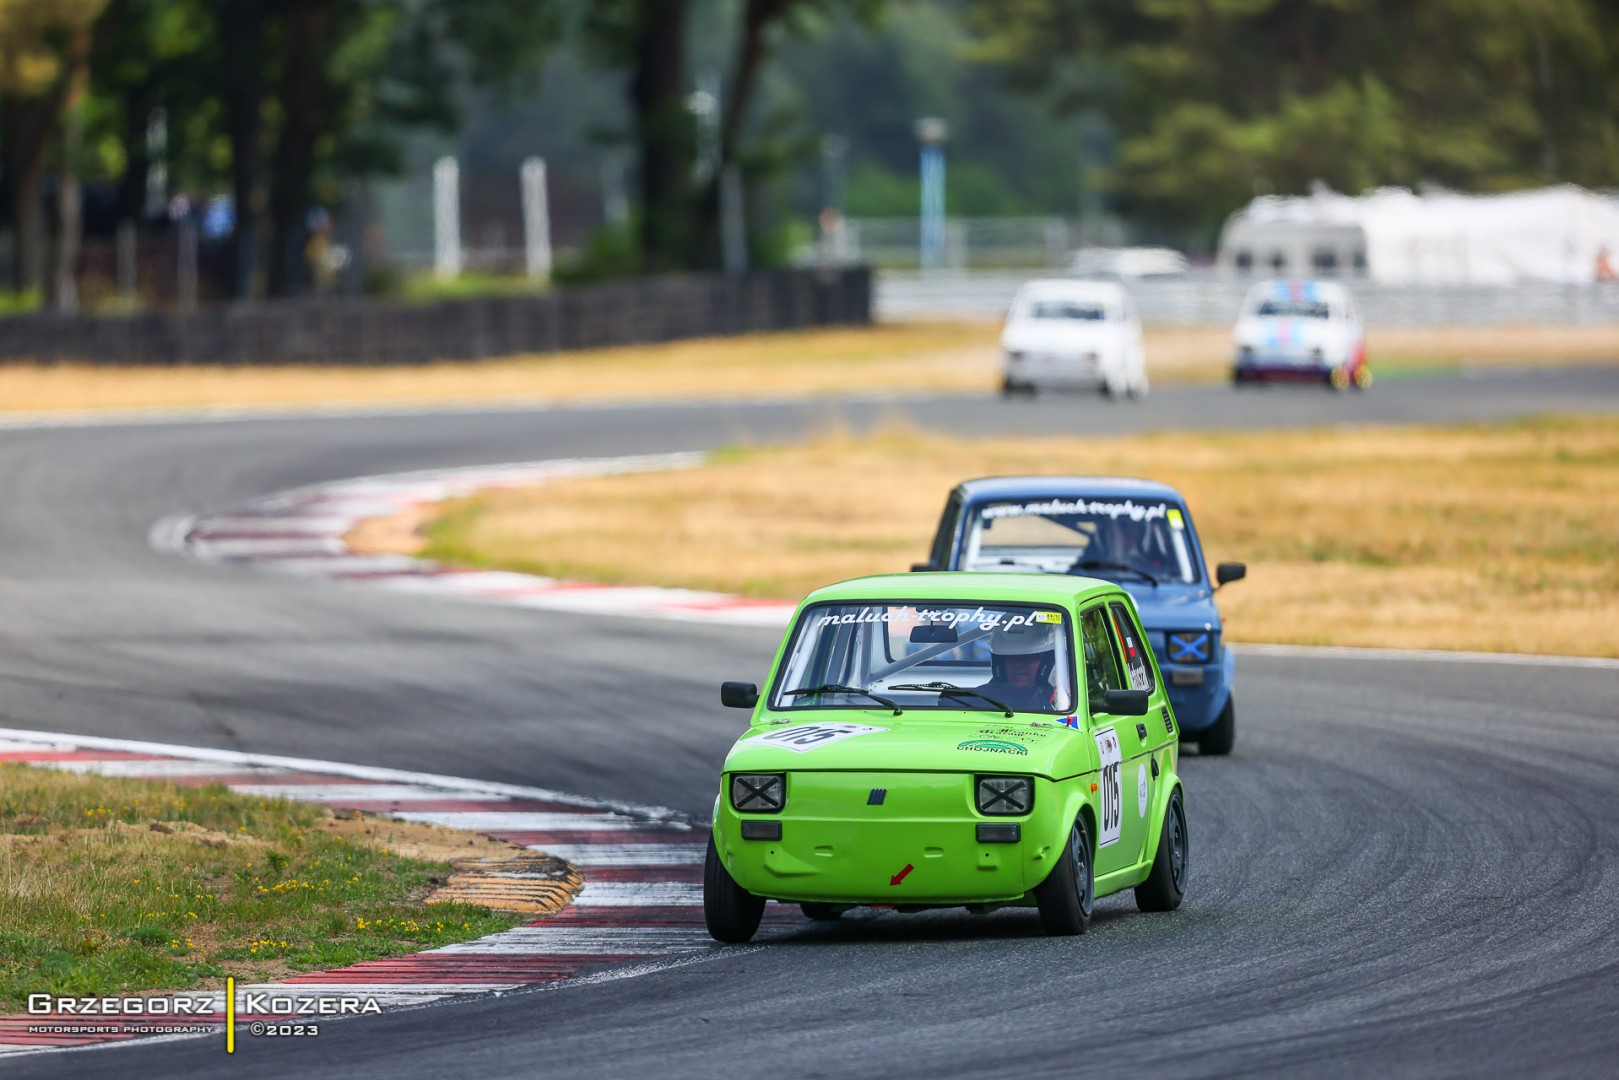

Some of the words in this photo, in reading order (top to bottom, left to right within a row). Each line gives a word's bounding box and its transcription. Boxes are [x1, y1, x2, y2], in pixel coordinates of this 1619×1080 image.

[817, 606, 1038, 632] maluch-trophy.pl
[763, 726, 853, 745] 015
[956, 745, 1029, 756] CHOJNACKI
[1103, 760, 1120, 832] 015
